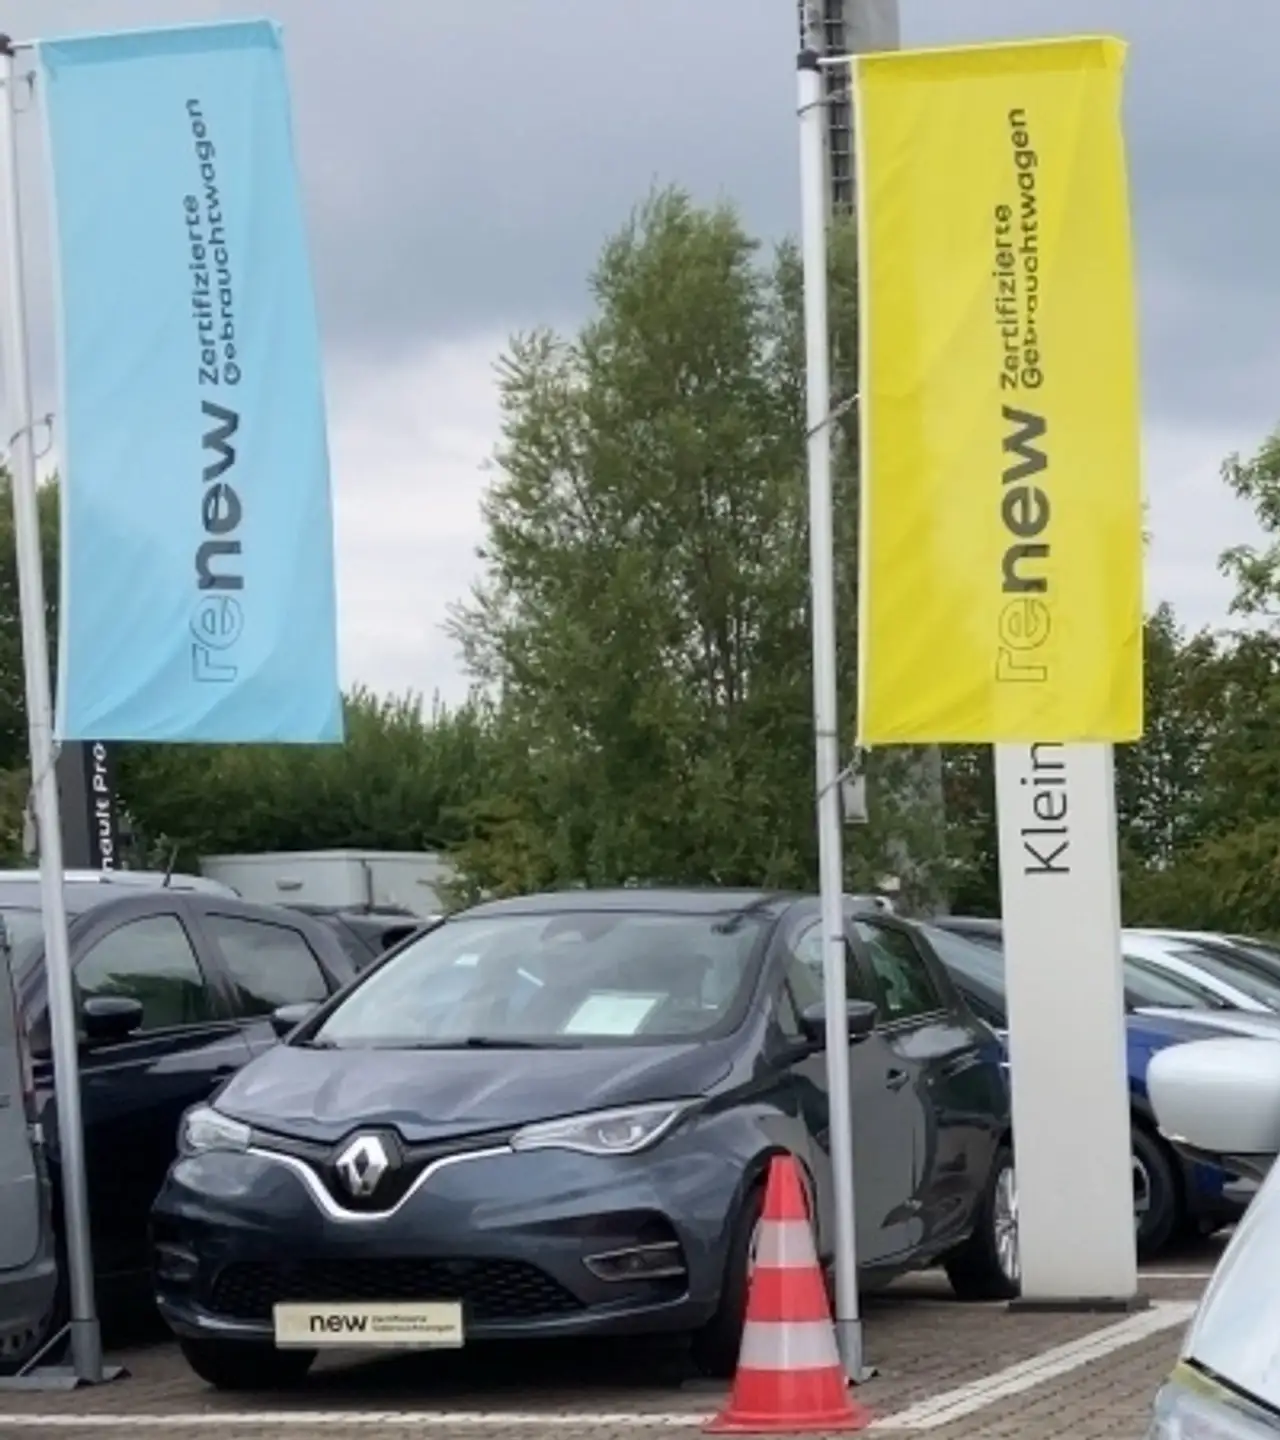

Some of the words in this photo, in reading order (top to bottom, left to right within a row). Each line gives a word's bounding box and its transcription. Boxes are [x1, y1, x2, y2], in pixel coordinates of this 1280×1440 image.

[183, 194, 219, 386] Zertifizierte
[186, 98, 241, 386] Gebrauchtwagen
[992, 204, 1019, 390] Zertifizierte
[1008, 107, 1044, 389] Gebrauchtwagen
[189, 399, 244, 684] renew
[995, 404, 1051, 683] renew
[1020, 742, 1070, 875] Klein
